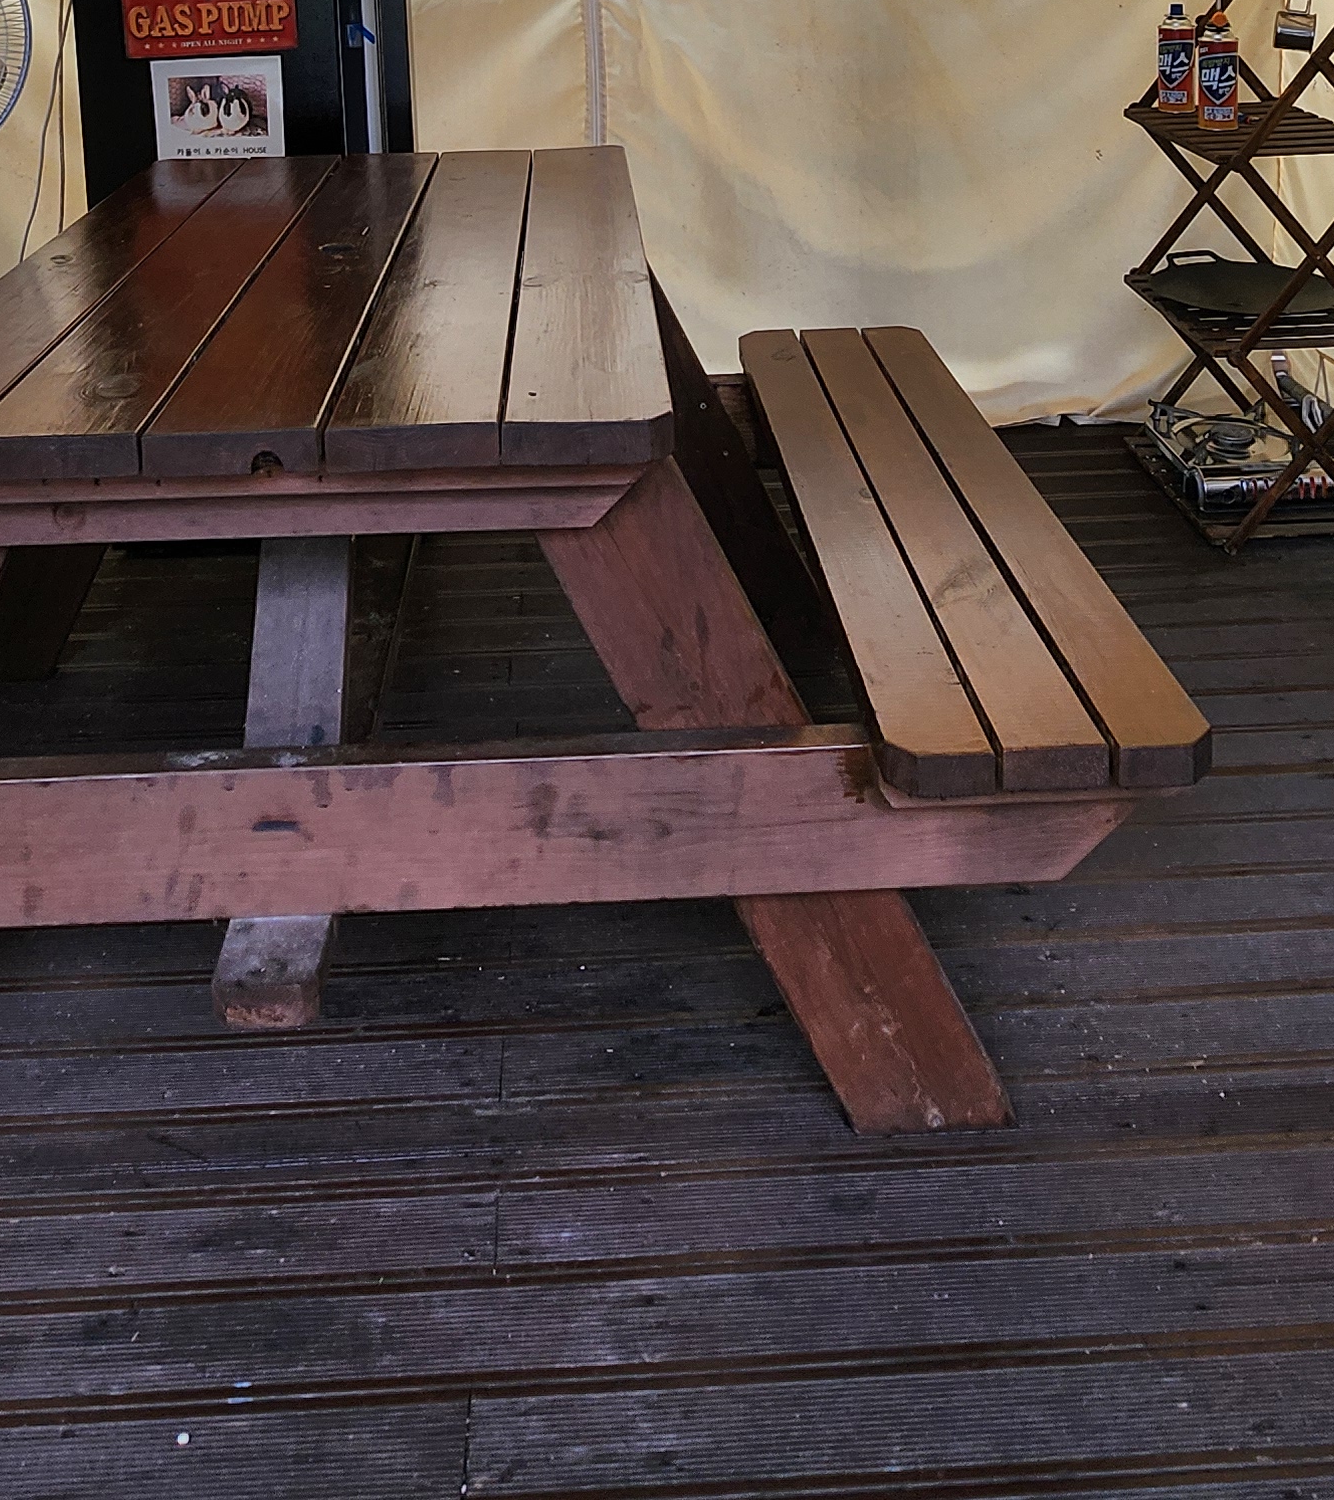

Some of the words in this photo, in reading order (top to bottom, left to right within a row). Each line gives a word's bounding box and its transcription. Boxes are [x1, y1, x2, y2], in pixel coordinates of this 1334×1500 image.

[128, 3, 194, 38] GAS
[197, 0, 290, 34] PUMP
[180, 40, 201, 48] OPEN
[202, 39, 216, 47] ALL
[218, 38, 243, 46] NIGHT
[1159, 52, 1189, 75] 맥스
[1201, 65, 1236, 90] 맥스
[243, 146, 267, 154] HOUSE
